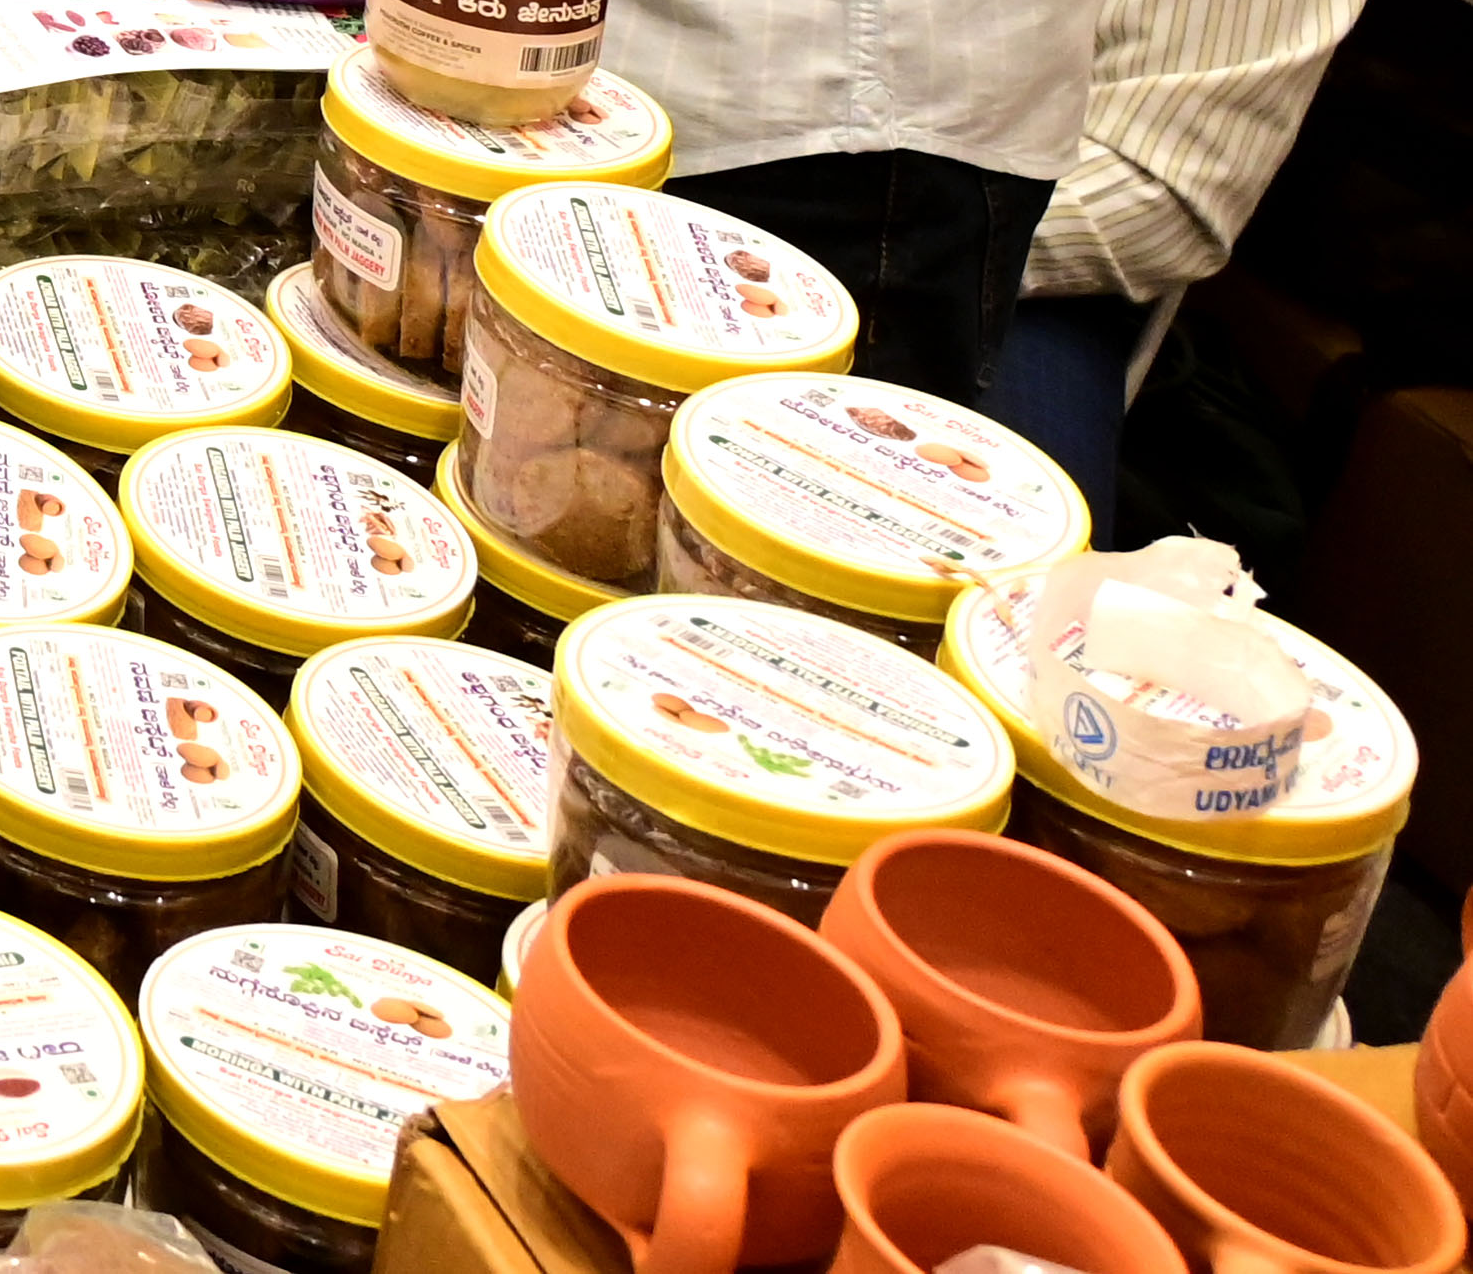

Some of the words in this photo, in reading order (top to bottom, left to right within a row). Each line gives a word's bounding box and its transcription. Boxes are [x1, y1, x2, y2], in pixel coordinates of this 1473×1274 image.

[902, 400, 945, 421] Sai
[940, 416, 1007, 450] Durga
[714, 439, 780, 472] JOWAR
[773, 468, 822, 493] WITH
[817, 490, 873, 517] PALM
[868, 514, 956, 557] JAGGERY
[83, 515, 101, 538] Sai
[84, 539, 111, 574] Durga
[5, 650, 34, 691] FOXTAIL
[15, 691, 38, 717] WITH
[20, 718, 45, 745] PALM
[27, 746, 56, 789] JAGGERY
[190, 1039, 276, 1080] MORINGA
[278, 1073, 326, 1099] WITH
[325, 1090, 381, 1120] PALM
